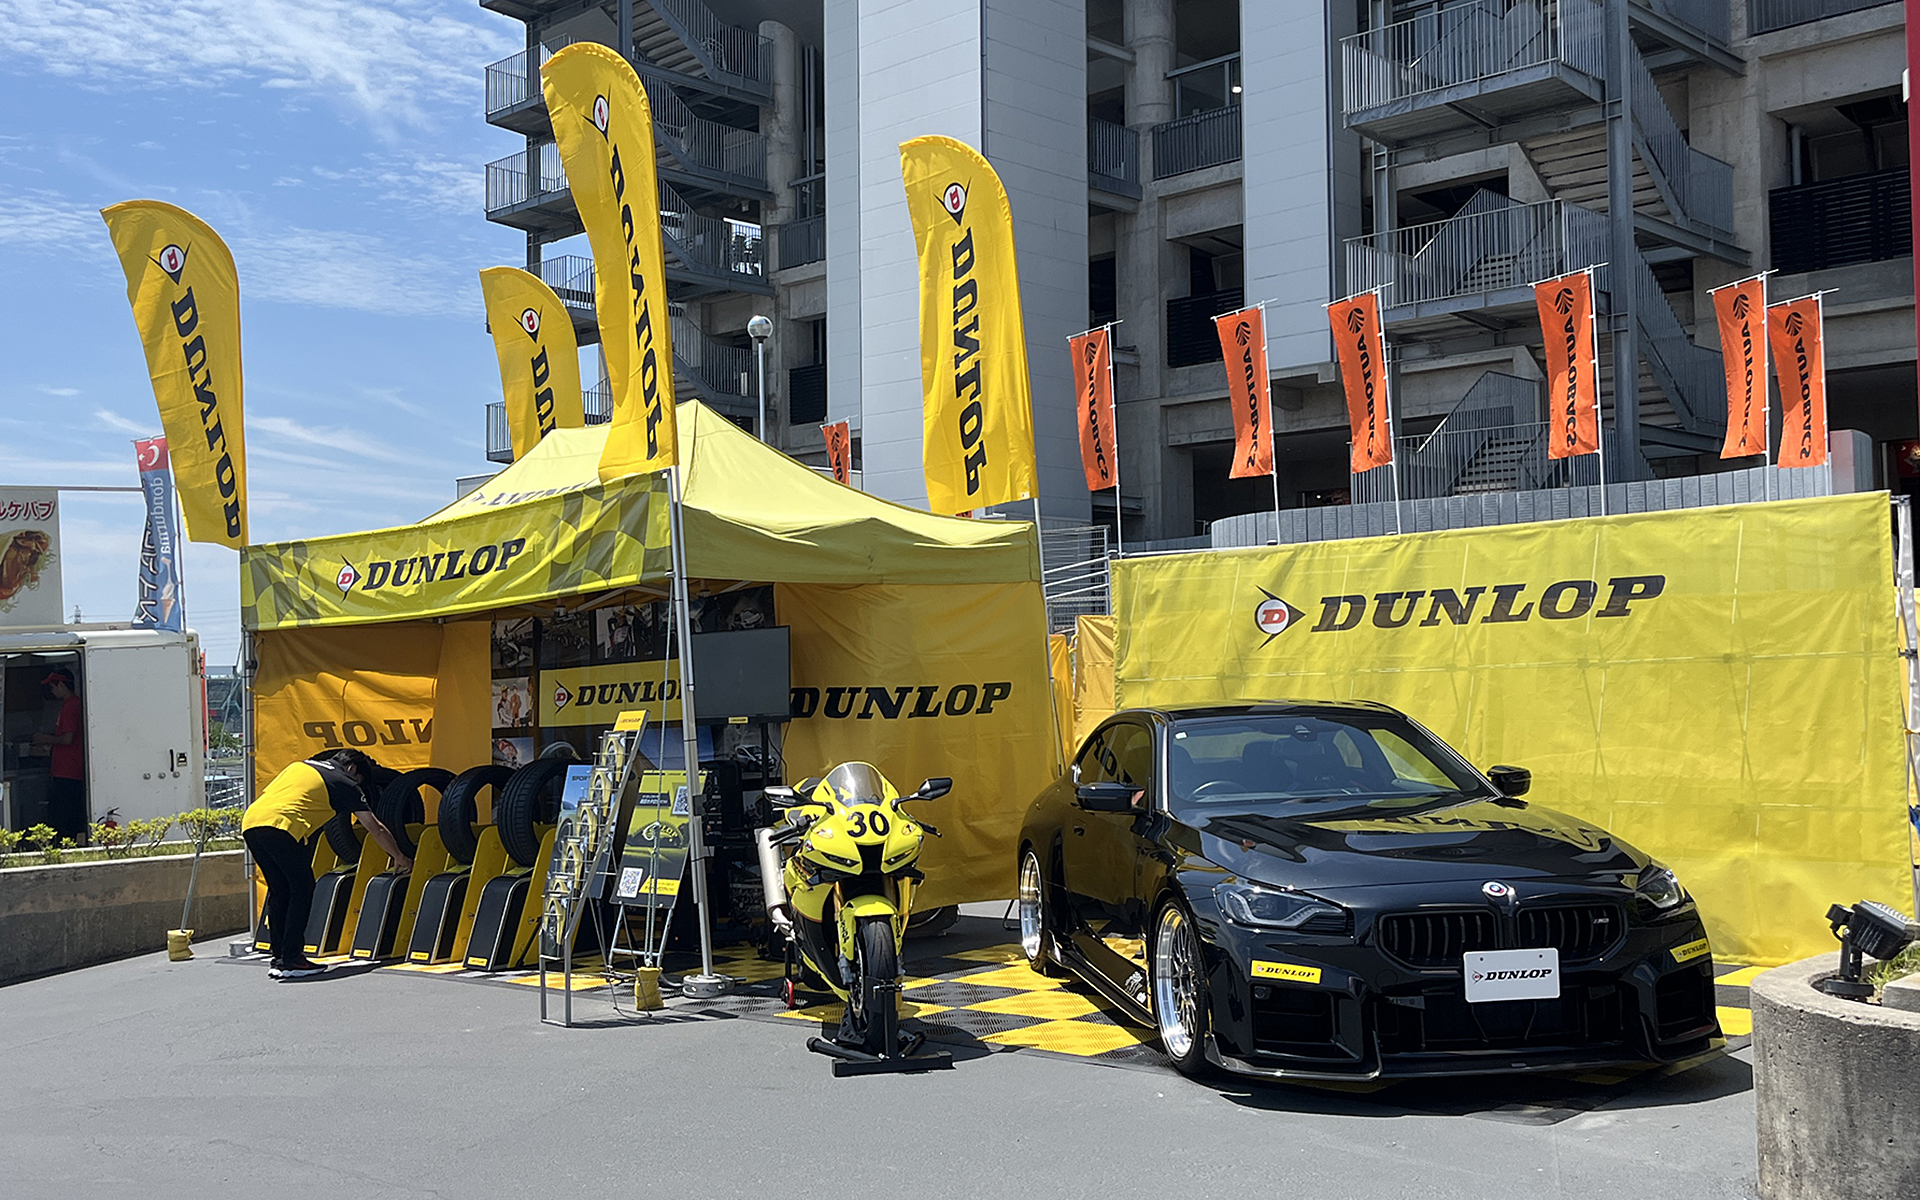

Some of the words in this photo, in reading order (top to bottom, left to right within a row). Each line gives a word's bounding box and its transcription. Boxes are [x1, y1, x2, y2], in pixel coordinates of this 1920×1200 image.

[362, 537, 526, 591] DUNLOP
[1310, 574, 1666, 632] DUNLOP
[575, 679, 682, 706] DUNLO
[790, 681, 1012, 719] DUNLOP
[847, 810, 890, 838] 30
[1681, 943, 1707, 956] DUNLOP
[1266, 966, 1315, 978] DUNLOP
[1485, 968, 1553, 981] DUNLOP
